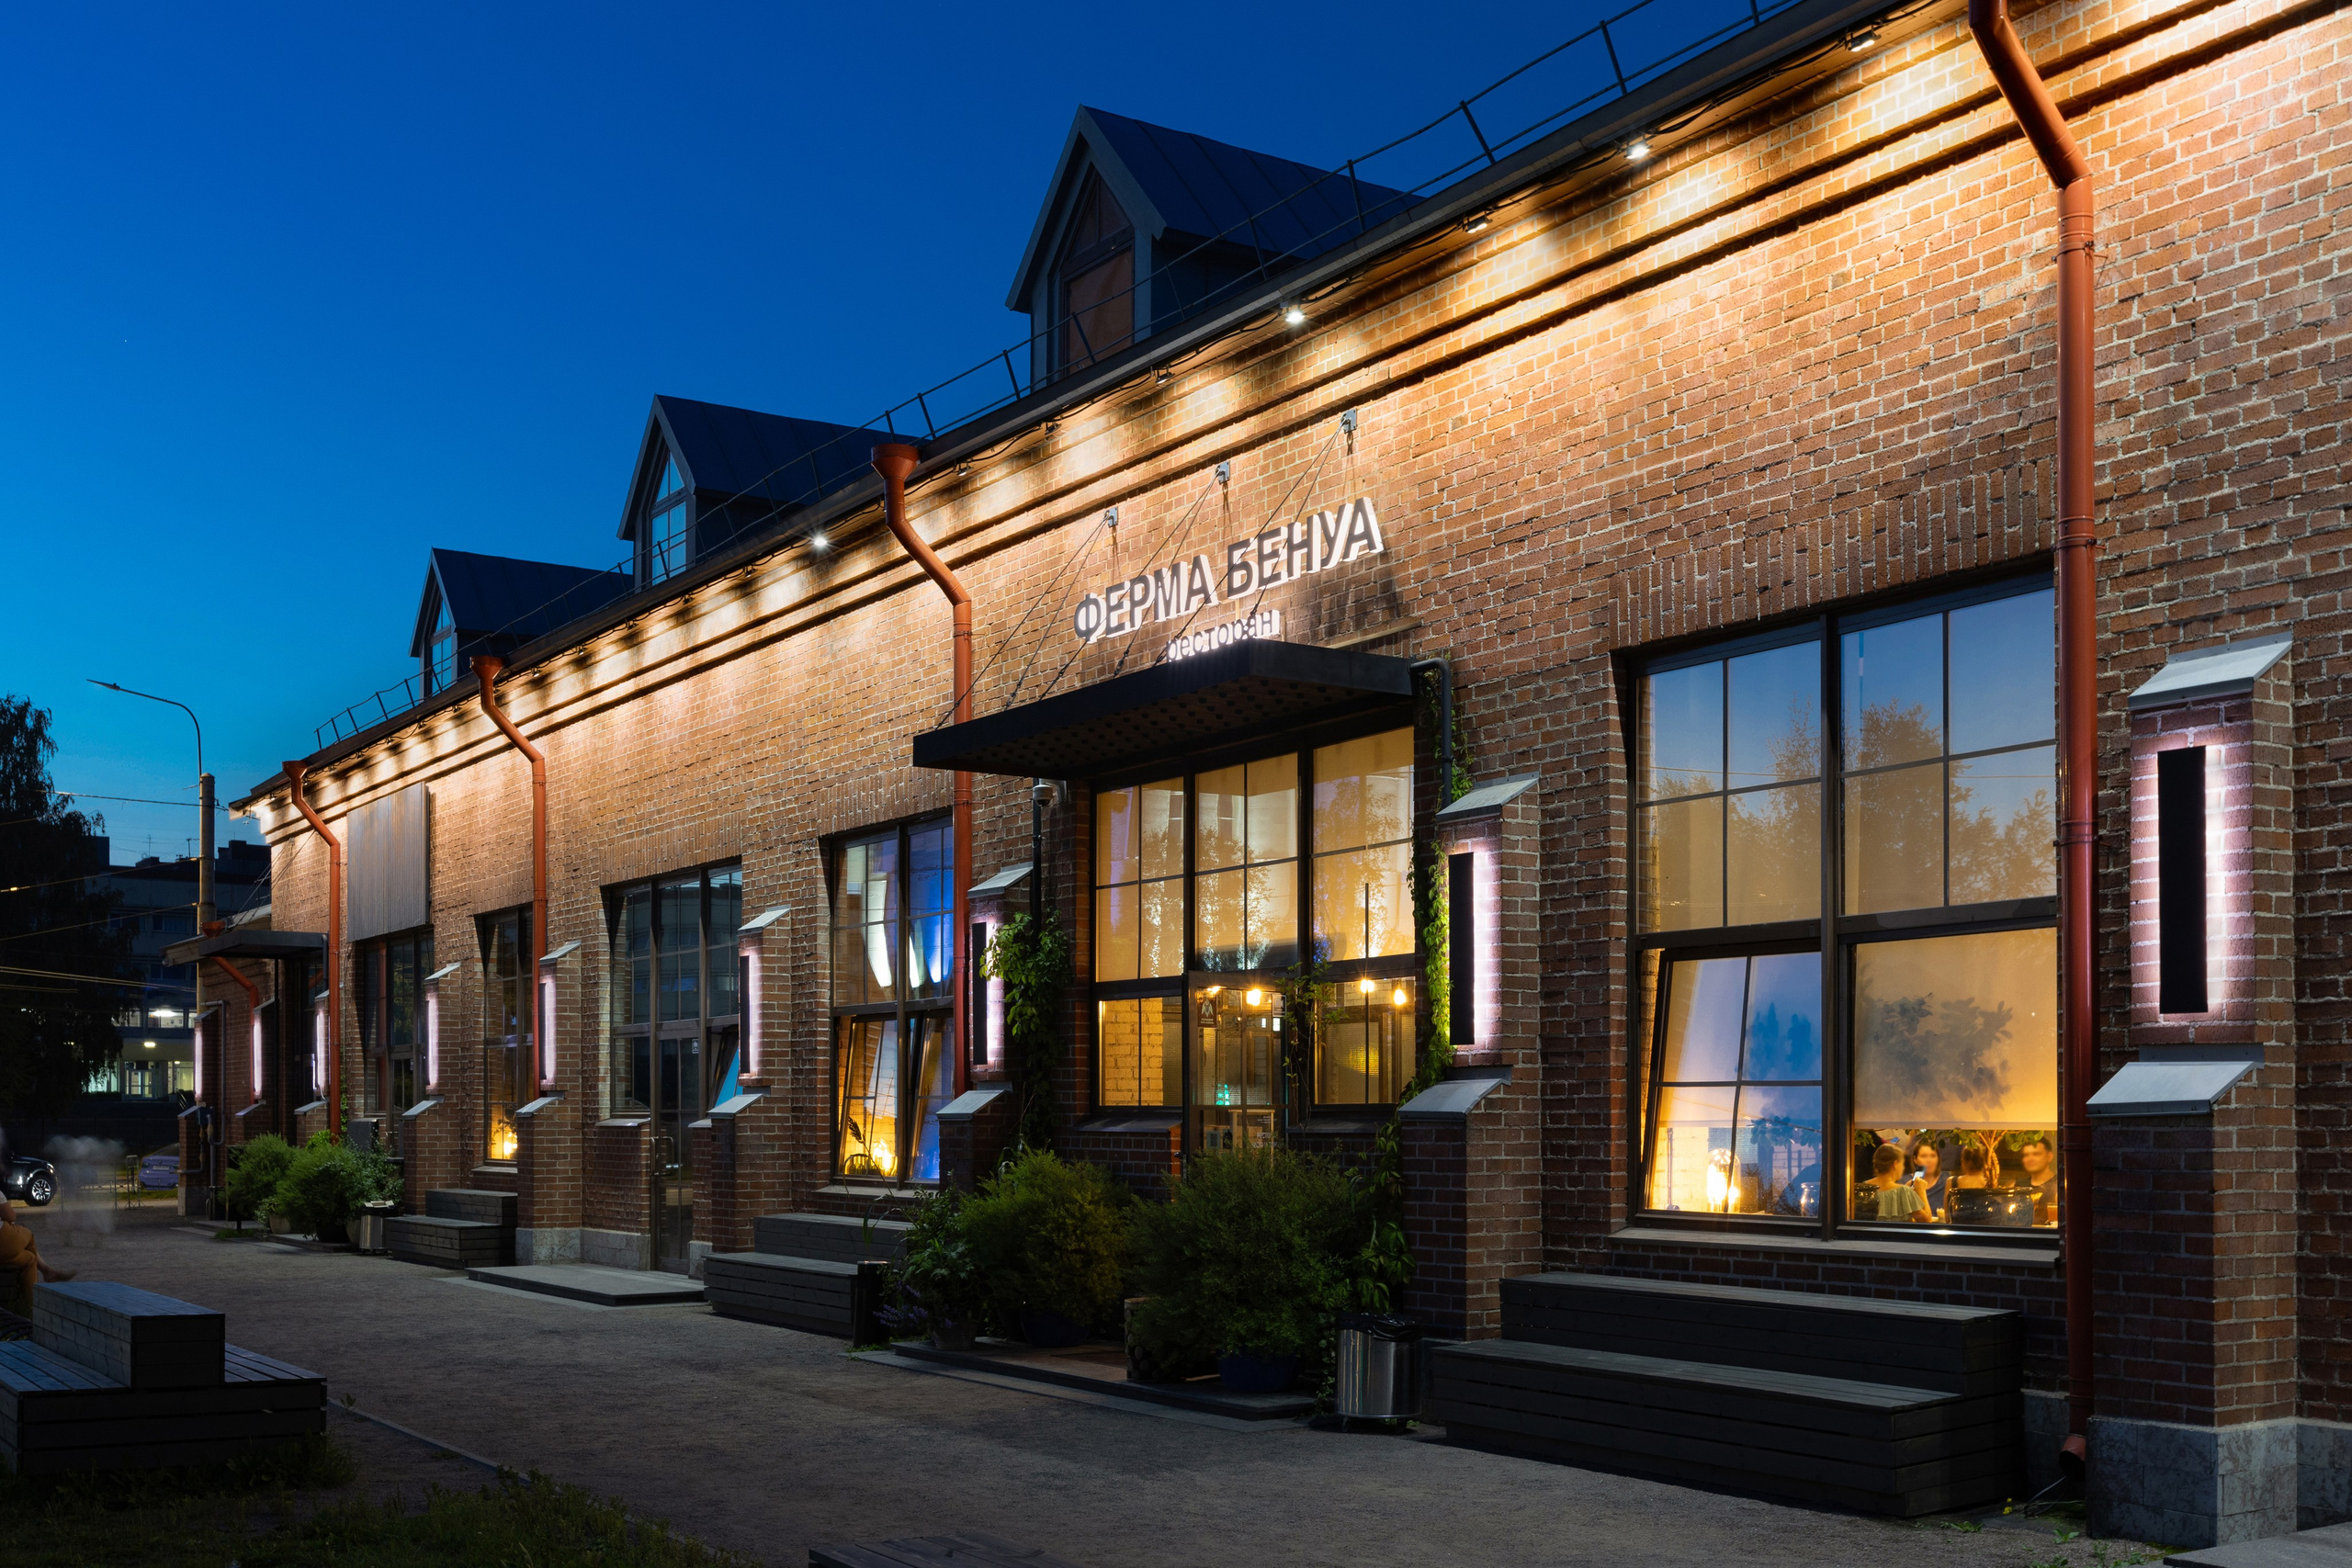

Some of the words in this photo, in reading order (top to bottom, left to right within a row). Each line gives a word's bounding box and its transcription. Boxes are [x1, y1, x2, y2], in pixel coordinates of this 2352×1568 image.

[1073, 554, 1219, 643] ФЕРМА
[1227, 497, 1384, 600] БЕНУА
[1166, 609, 1281, 662] ресторан
